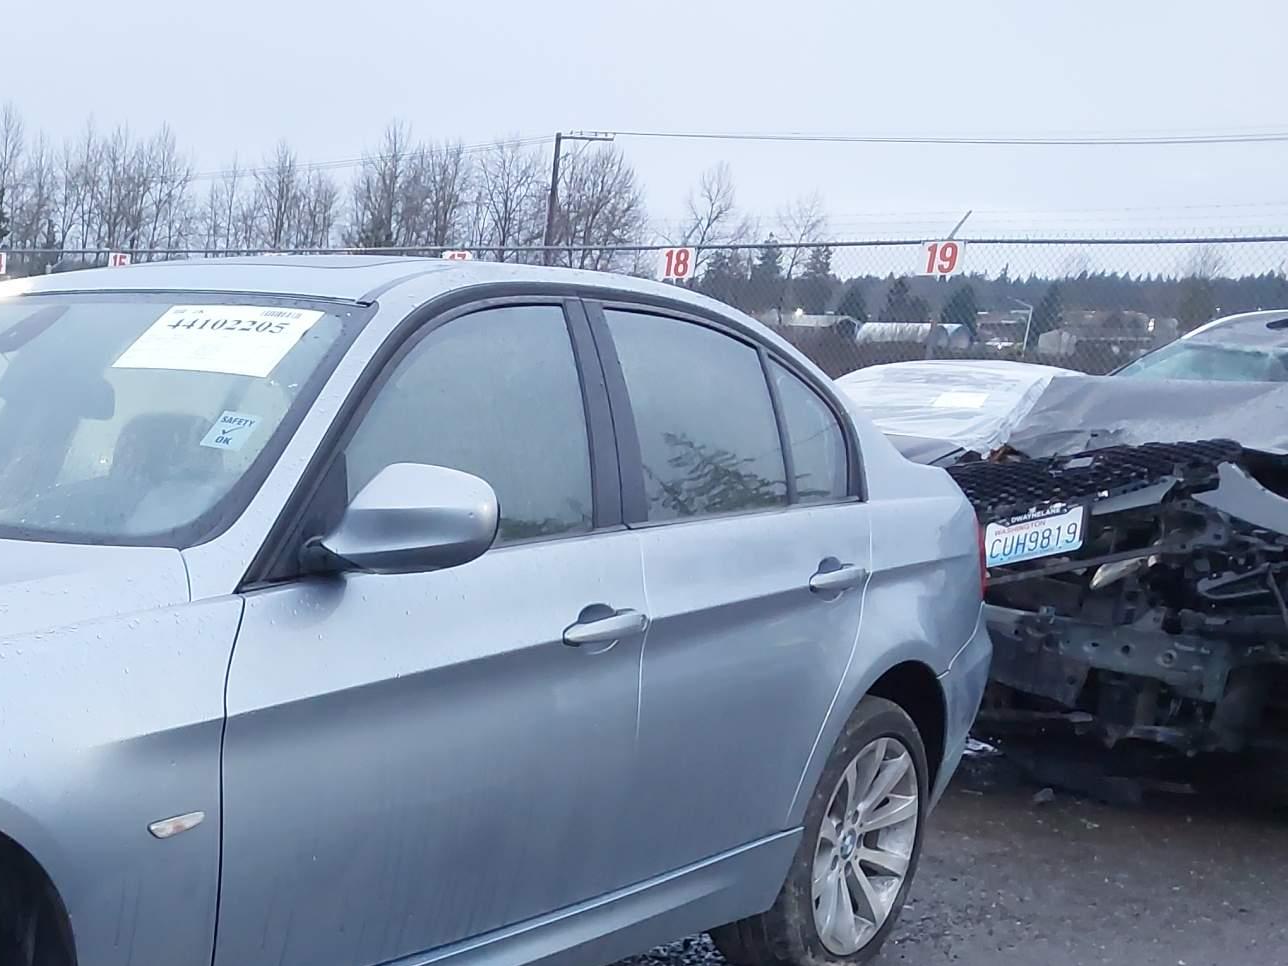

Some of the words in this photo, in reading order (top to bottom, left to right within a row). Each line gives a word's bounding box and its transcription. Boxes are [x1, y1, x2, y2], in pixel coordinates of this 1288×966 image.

[665, 248, 690, 276] 18
[926, 242, 958, 273] 19
[167, 317, 290, 334] 44102205
[220, 416, 256, 427] SAFETY
[215, 435, 232, 445] OK
[990, 522, 1078, 559] CUH9819
